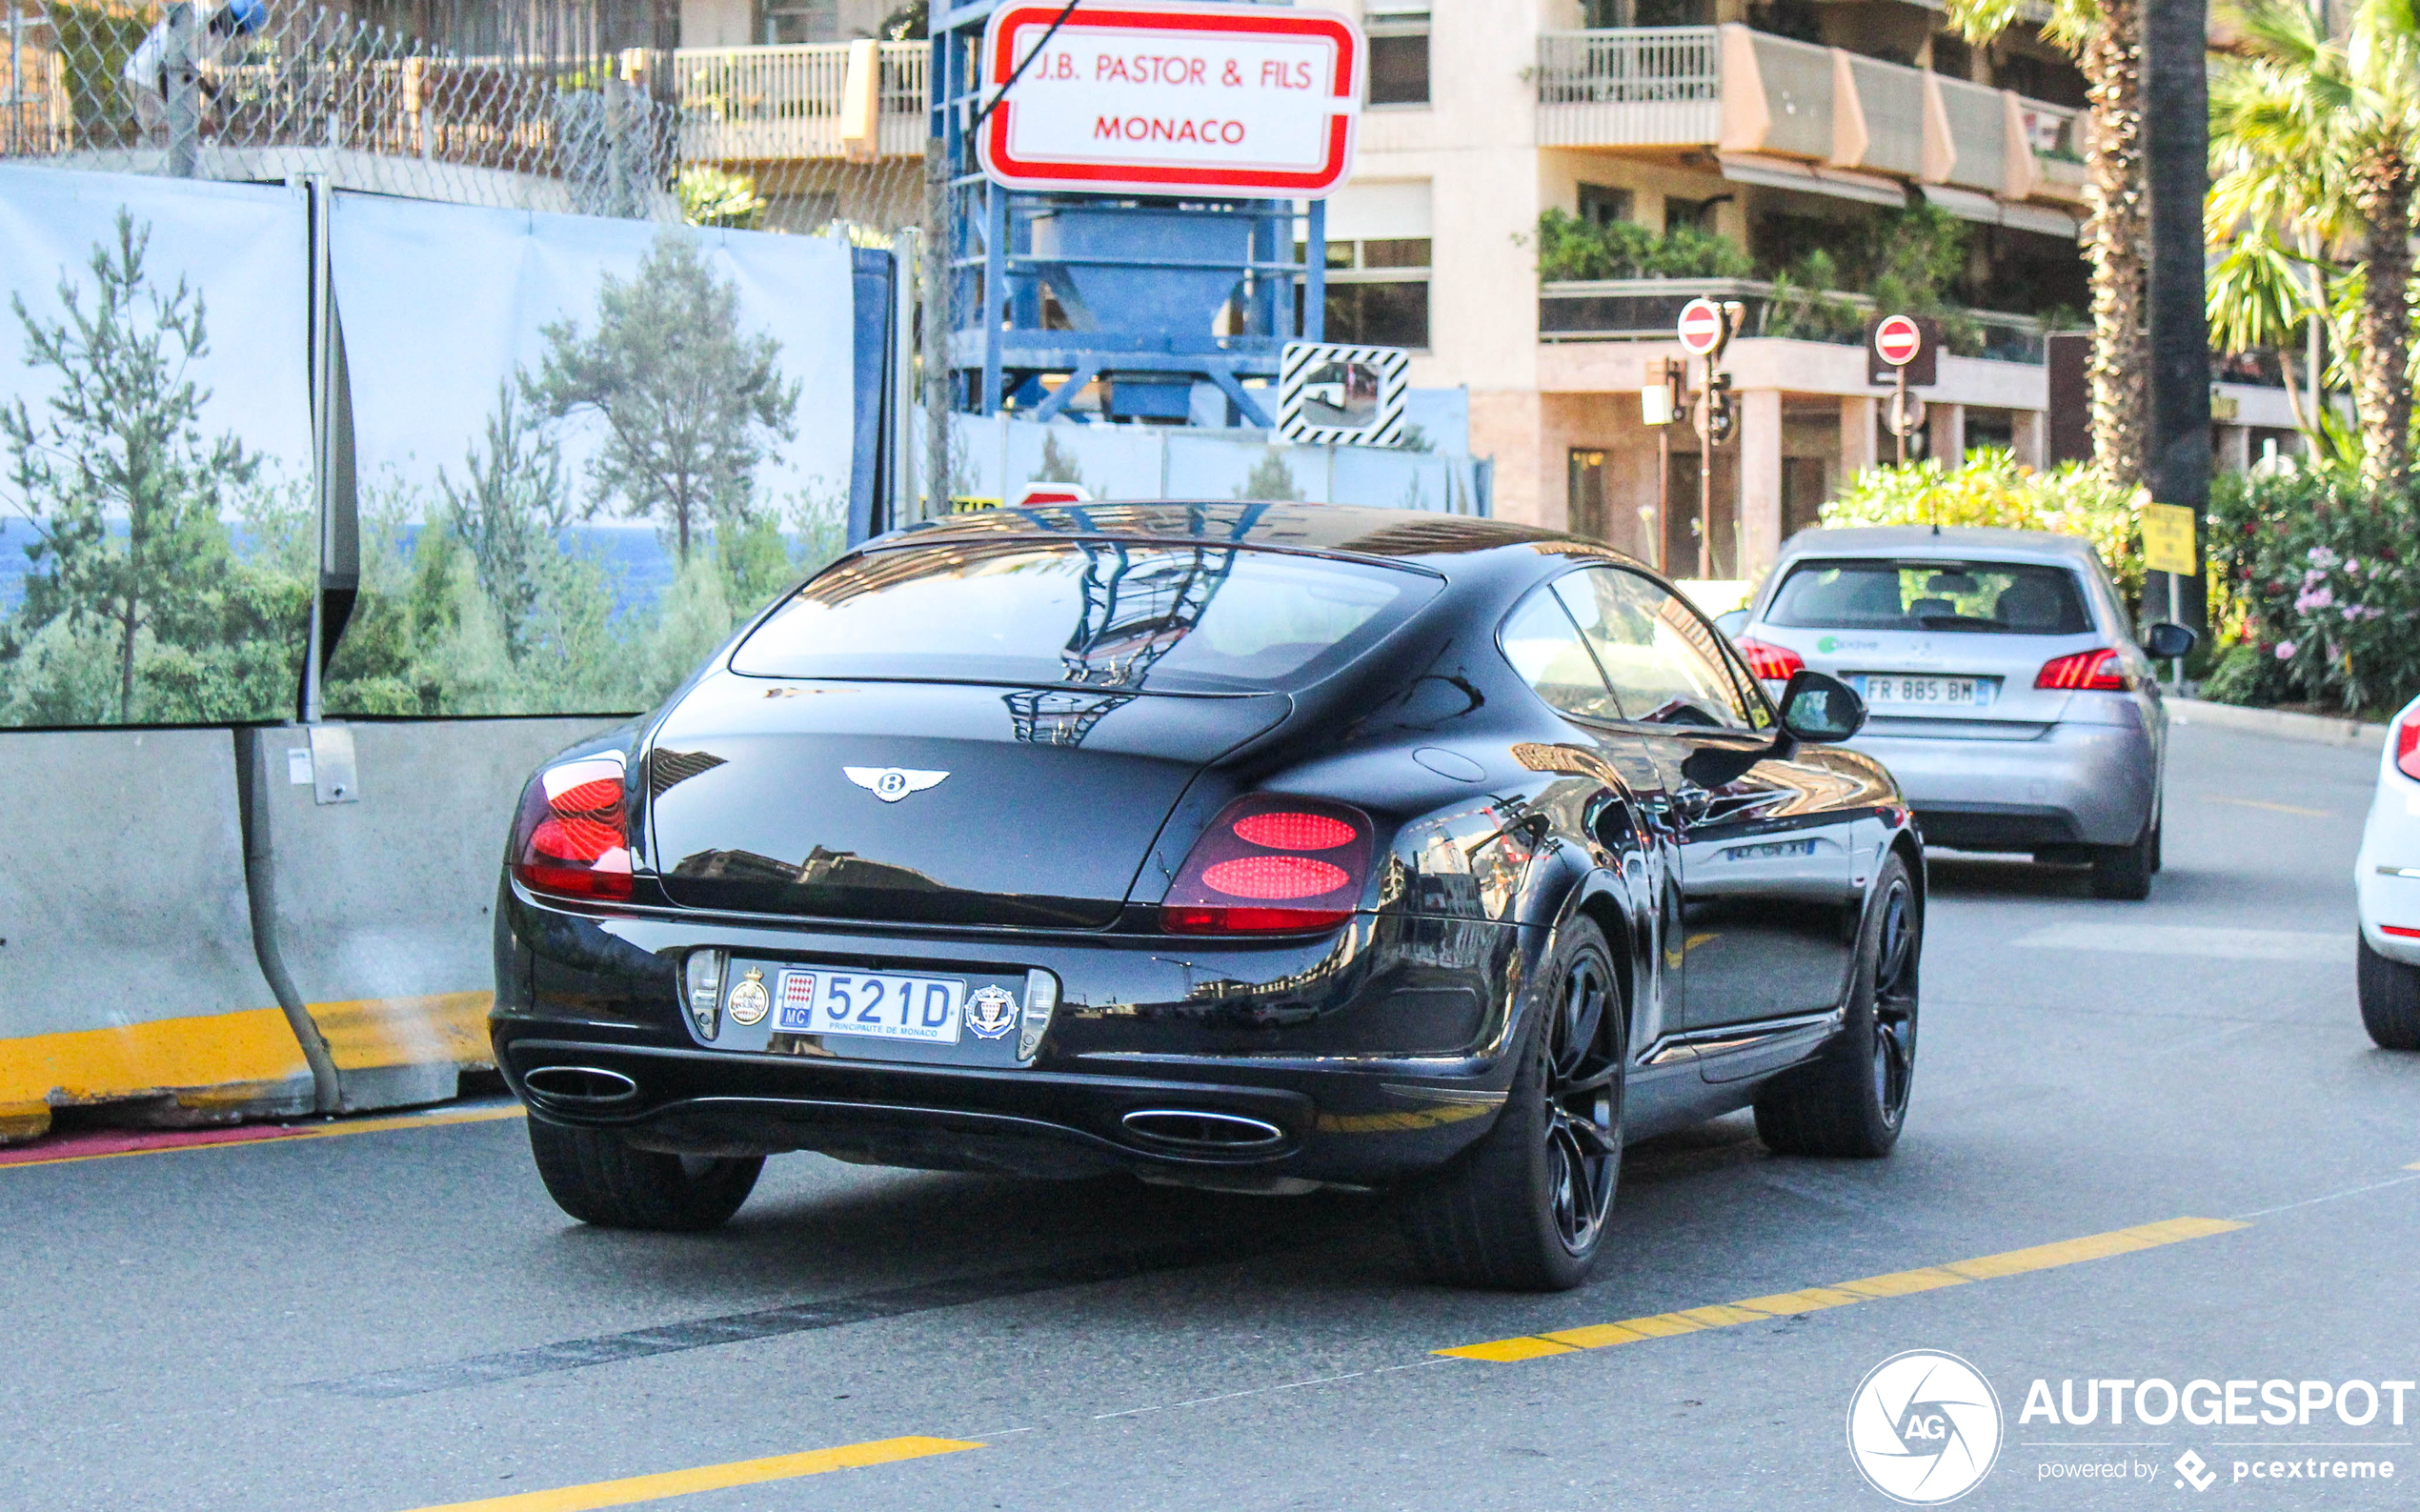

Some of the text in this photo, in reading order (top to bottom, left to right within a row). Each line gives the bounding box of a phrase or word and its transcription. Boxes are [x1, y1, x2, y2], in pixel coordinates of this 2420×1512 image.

[1035, 52, 1312, 89] J.B. PASTOR & FILS
[1094, 115, 1244, 144] MONACO
[785, 1008, 807, 1024] MC
[827, 977, 950, 1028] 521D
[829, 1021, 938, 1038] PRINCIPAUTE DE MONACO
